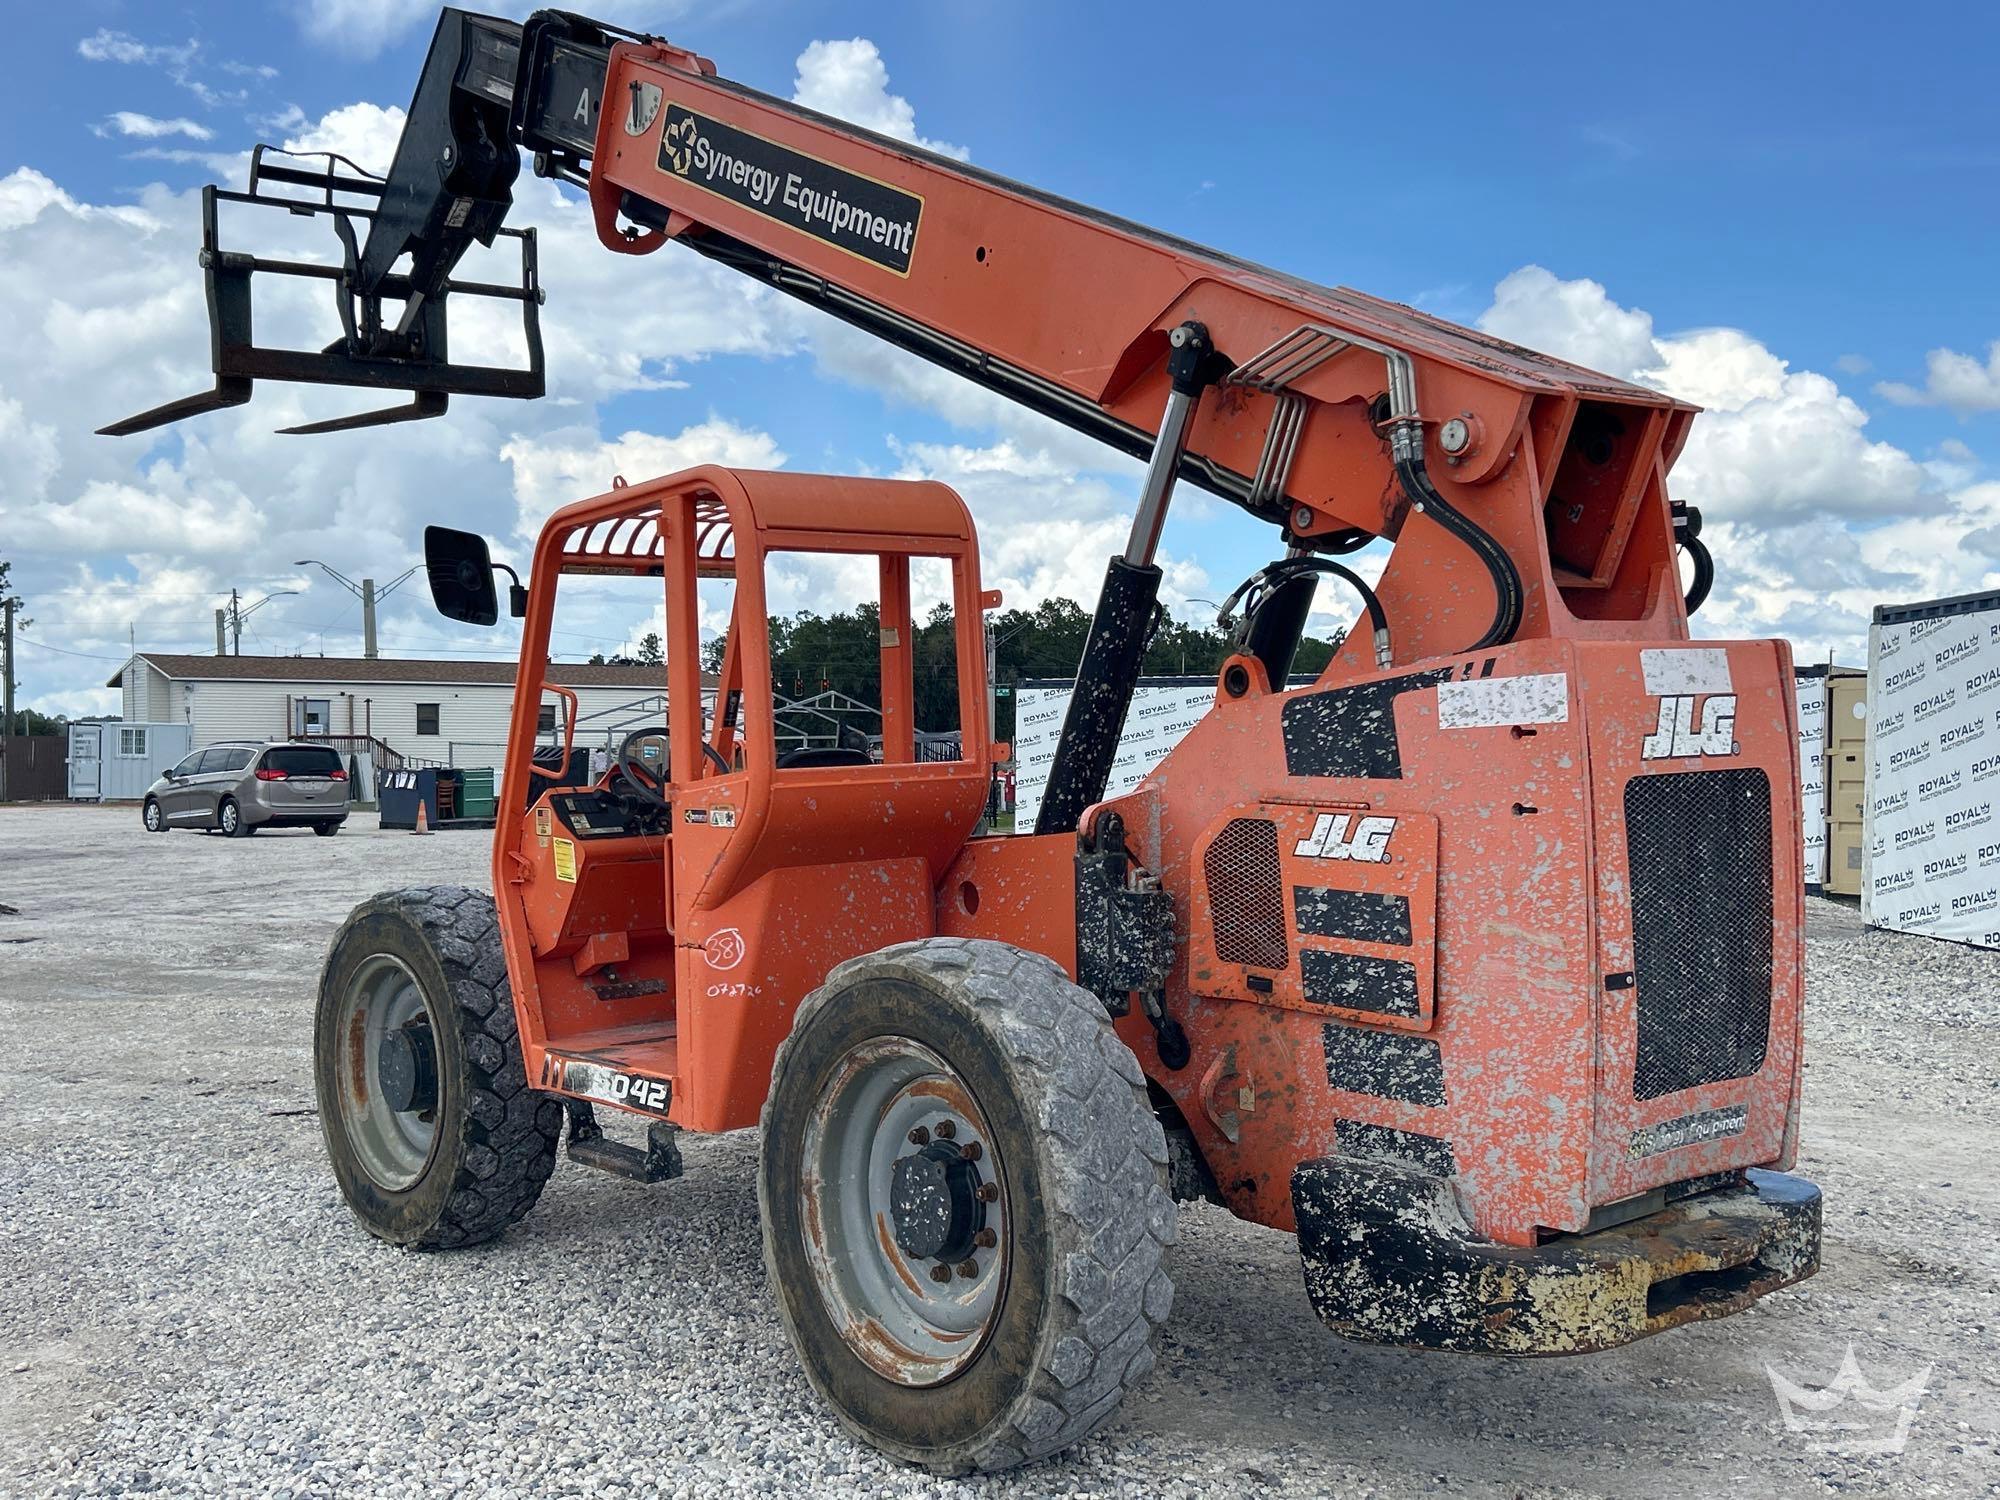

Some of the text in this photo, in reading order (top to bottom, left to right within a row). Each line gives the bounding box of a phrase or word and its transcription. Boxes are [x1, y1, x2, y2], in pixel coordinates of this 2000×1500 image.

[573, 87, 589, 126] A
[694, 137, 913, 254] Synergy Equipment
[1935, 640, 1970, 664] ROYAL
[1936, 657, 1960, 672] AUCTION
[1885, 666, 1917, 688] ROYAL
[1967, 682, 1992, 699] AUCTION
[1138, 704, 1168, 716] ROYAL
[1913, 692, 1947, 715] ROYAL
[1023, 711, 1051, 723] ROYAL
[1163, 719, 1194, 732] ROYAL
[1640, 693, 1738, 761] JLG
[1938, 722, 1976, 745] ROYAL
[1941, 738, 1966, 753] AUCTION
[1889, 744, 1922, 766] ROYAL
[1918, 774, 1952, 795] ROYAL
[1972, 768, 1998, 783] AUCTION
[1919, 788, 1942, 802] AUCTION
[1945, 806, 1981, 827] ROYAL
[1895, 824, 1926, 844] ROYAL
[1946, 821, 1971, 835] AUCTION
[1292, 812, 1398, 863] JLG
[1924, 856, 1958, 875] ROYAL
[1874, 872, 1906, 889] ROYAL
[1925, 871, 1949, 883] AUCTION
[1951, 892, 1988, 910] ROYAL
[1899, 905, 1932, 922] ROYAL
[1952, 907, 1978, 918] AUCTION
[594, 1068, 668, 1109] 042
